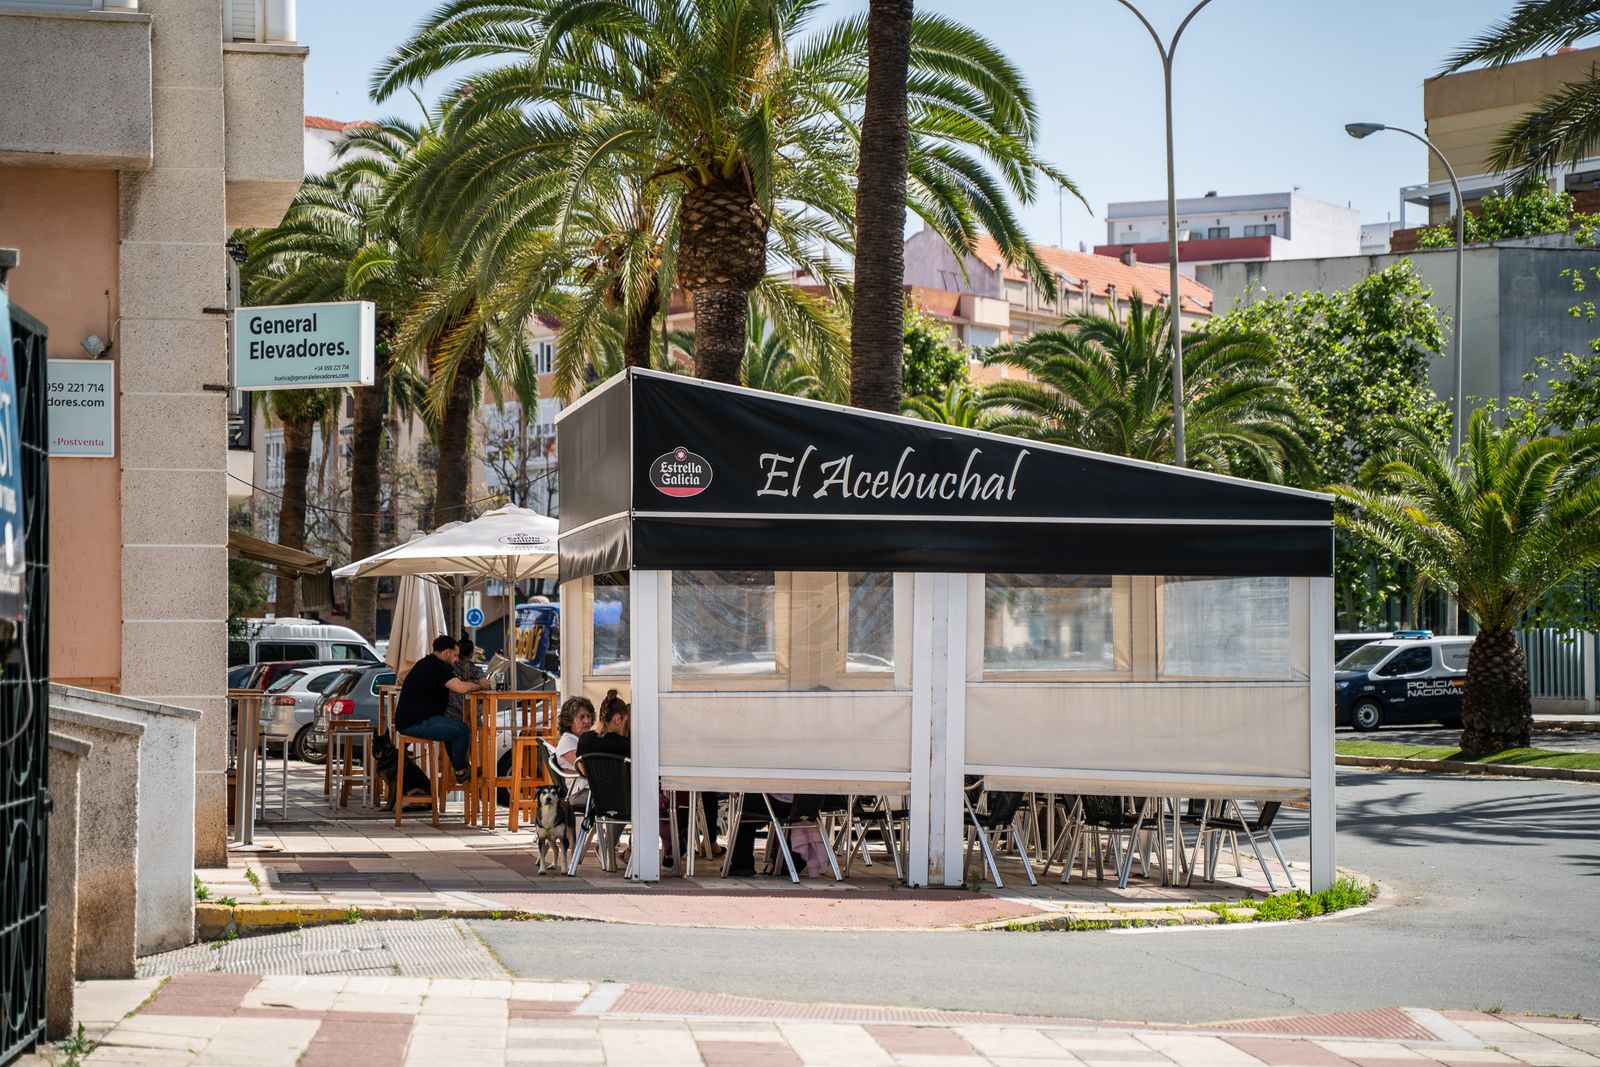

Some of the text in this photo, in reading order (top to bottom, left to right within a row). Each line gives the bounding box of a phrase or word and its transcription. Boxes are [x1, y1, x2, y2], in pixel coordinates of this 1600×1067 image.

[249, 313, 317, 335] General
[249, 338, 350, 360] Elevadores.
[274, 372, 350, 382] huelva@generalelevadores.com
[67, 383, 84, 392] 221
[87, 383, 104, 393] 714
[52, 437, 104, 446] +Postventa
[660, 461, 702, 474] Estrella
[756, 445, 1031, 501] El Acebuchal
[661, 473, 701, 485] Galicia
[1407, 680, 1455, 689] POLICIA
[1407, 687, 1464, 697] NACIONAL
